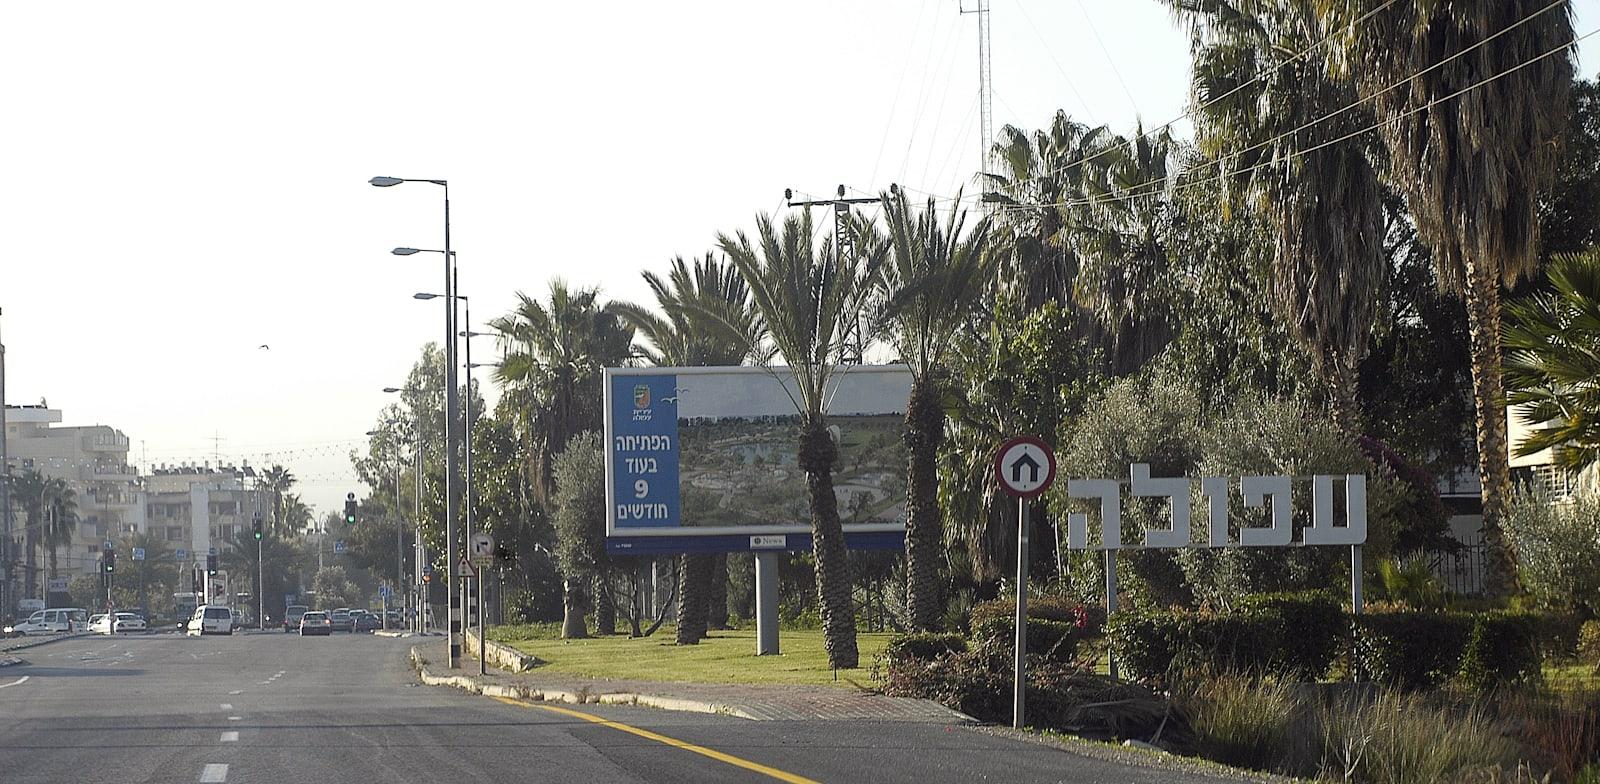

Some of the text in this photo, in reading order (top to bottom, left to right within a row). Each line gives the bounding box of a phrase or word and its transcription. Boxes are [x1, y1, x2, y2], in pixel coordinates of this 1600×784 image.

[616, 435, 671, 451] הפתיחה
[625, 457, 657, 475] בעוד
[634, 479, 649, 498] 9
[617, 503, 668, 519] חודשים
[1068, 463, 1367, 549] עפולה
